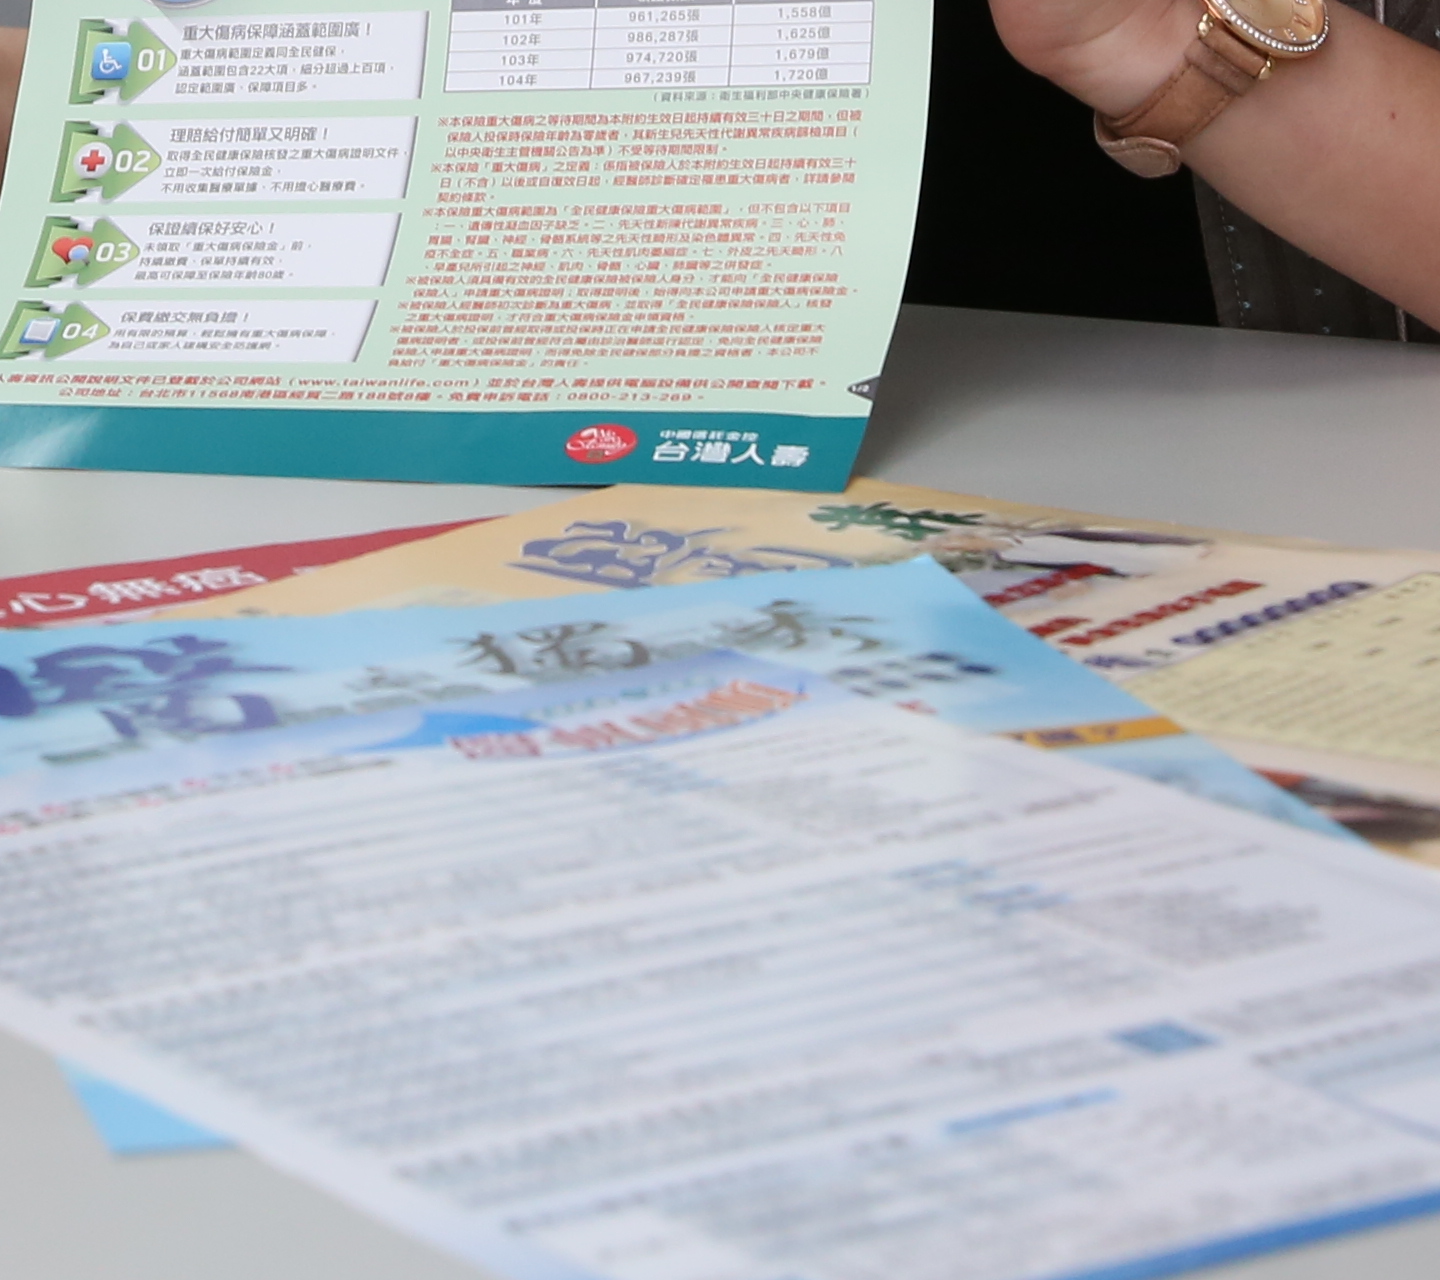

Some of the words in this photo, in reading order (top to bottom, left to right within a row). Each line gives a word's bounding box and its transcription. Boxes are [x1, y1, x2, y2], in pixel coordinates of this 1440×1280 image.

[503, 11, 542, 26] 101年
[628, 8, 701, 24] 961,265張
[777, 5, 831, 20] 1,558億
[502, 32, 541, 47] 102年
[627, 29, 699, 44] 986,287張
[776, 26, 831, 41] 1,625億
[136, 48, 167, 72] 01
[500, 52, 539, 67] 103年
[625, 49, 698, 65] 974,720張
[775, 46, 830, 61] 1,679億
[498, 73, 538, 87] 104年
[624, 70, 696, 85] 967,239張
[774, 67, 828, 82] 1,720億
[115, 150, 151, 174] 02
[95, 241, 133, 263] 03
[61, 323, 100, 339] 04
[652, 441, 811, 469] 台灣人壽
